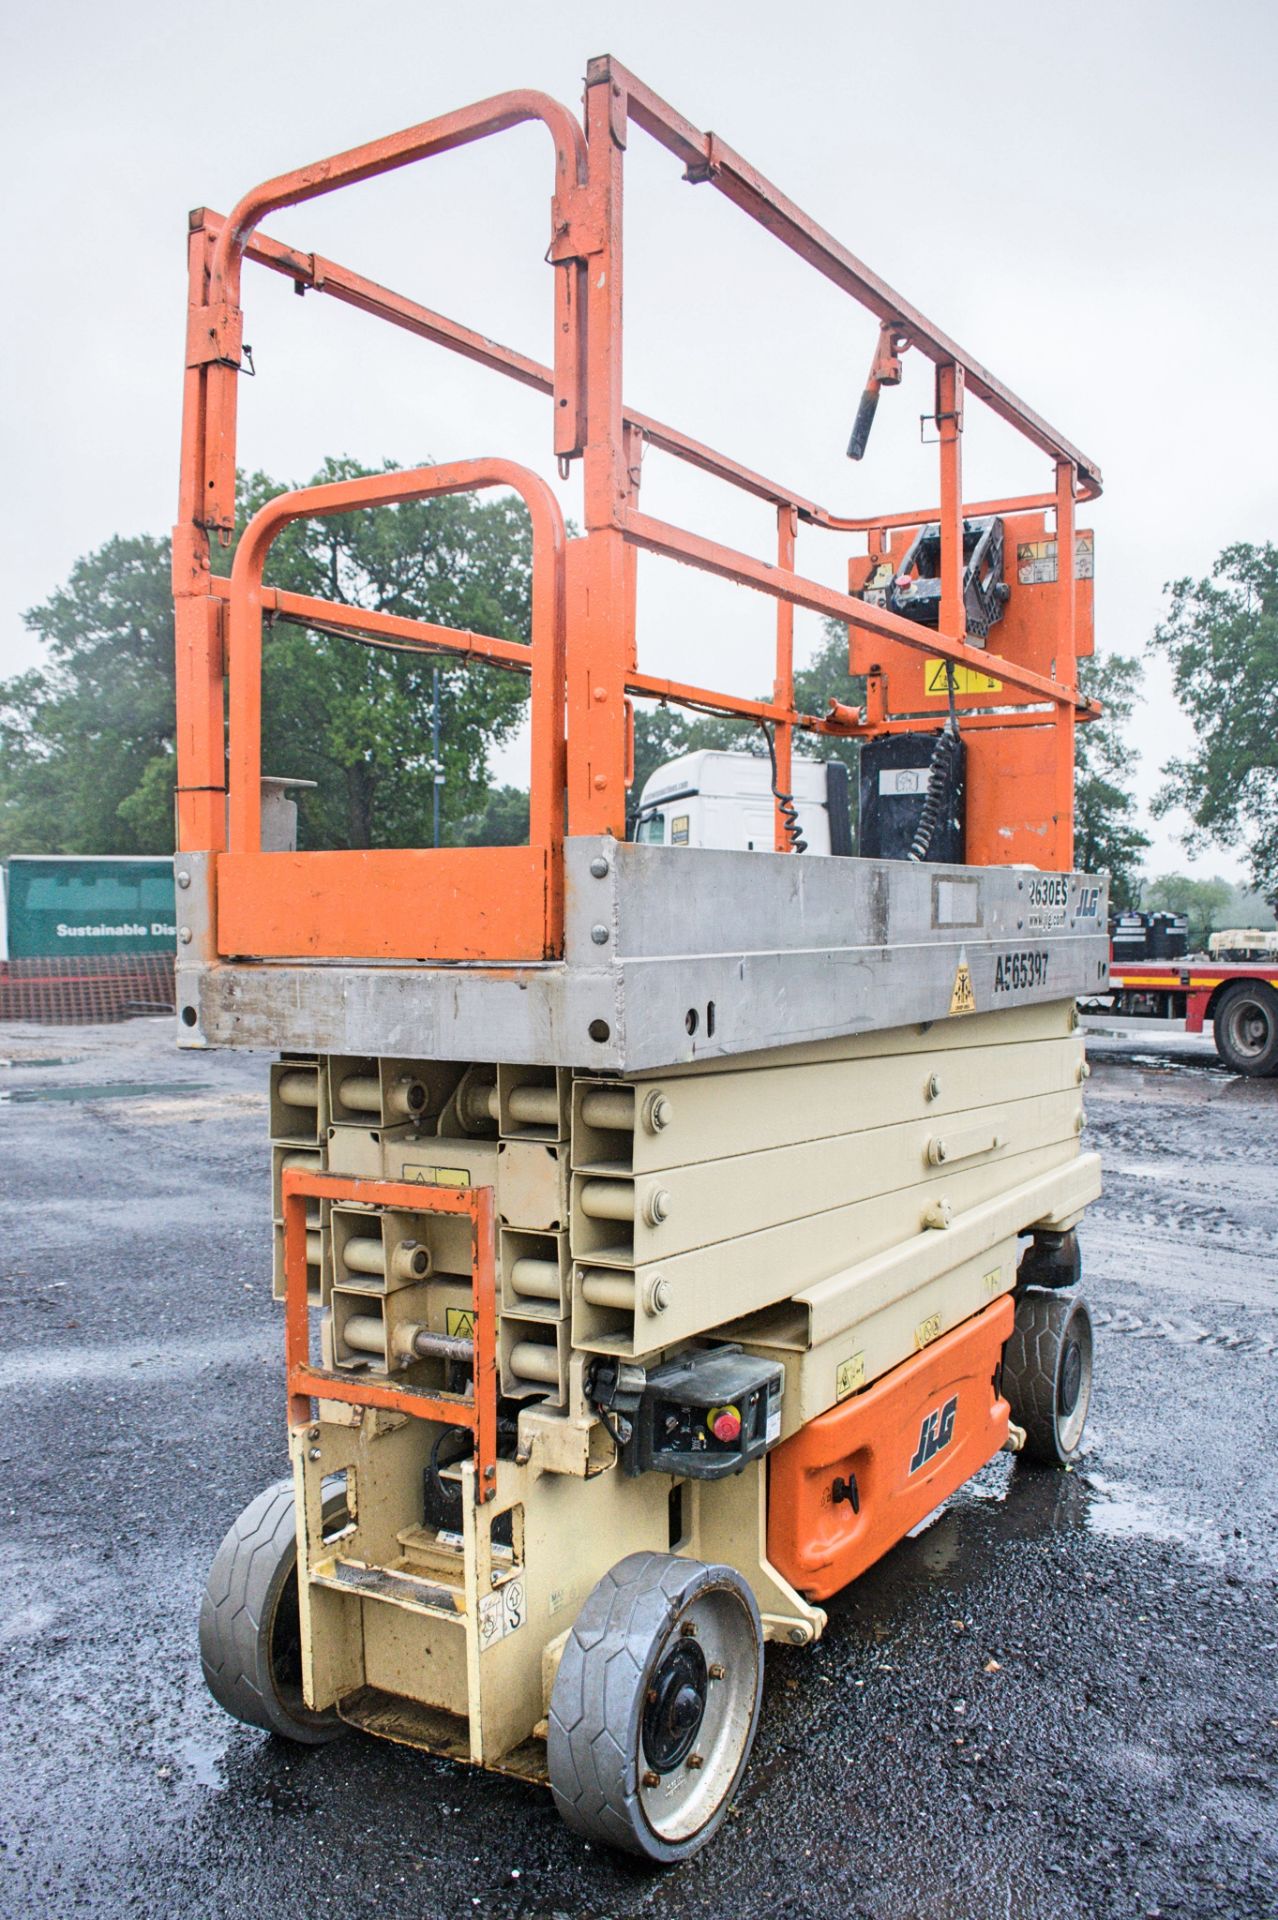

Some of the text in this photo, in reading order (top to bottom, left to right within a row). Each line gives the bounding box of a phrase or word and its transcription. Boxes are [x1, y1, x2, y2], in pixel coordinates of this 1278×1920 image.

[1029, 879, 1068, 906] 2630ES
[1075, 888, 1099, 918] JLG
[57, 923, 177, 936] Sustainable Dis
[995, 950, 1049, 992] A565397
[908, 1393, 959, 1477] JLG
